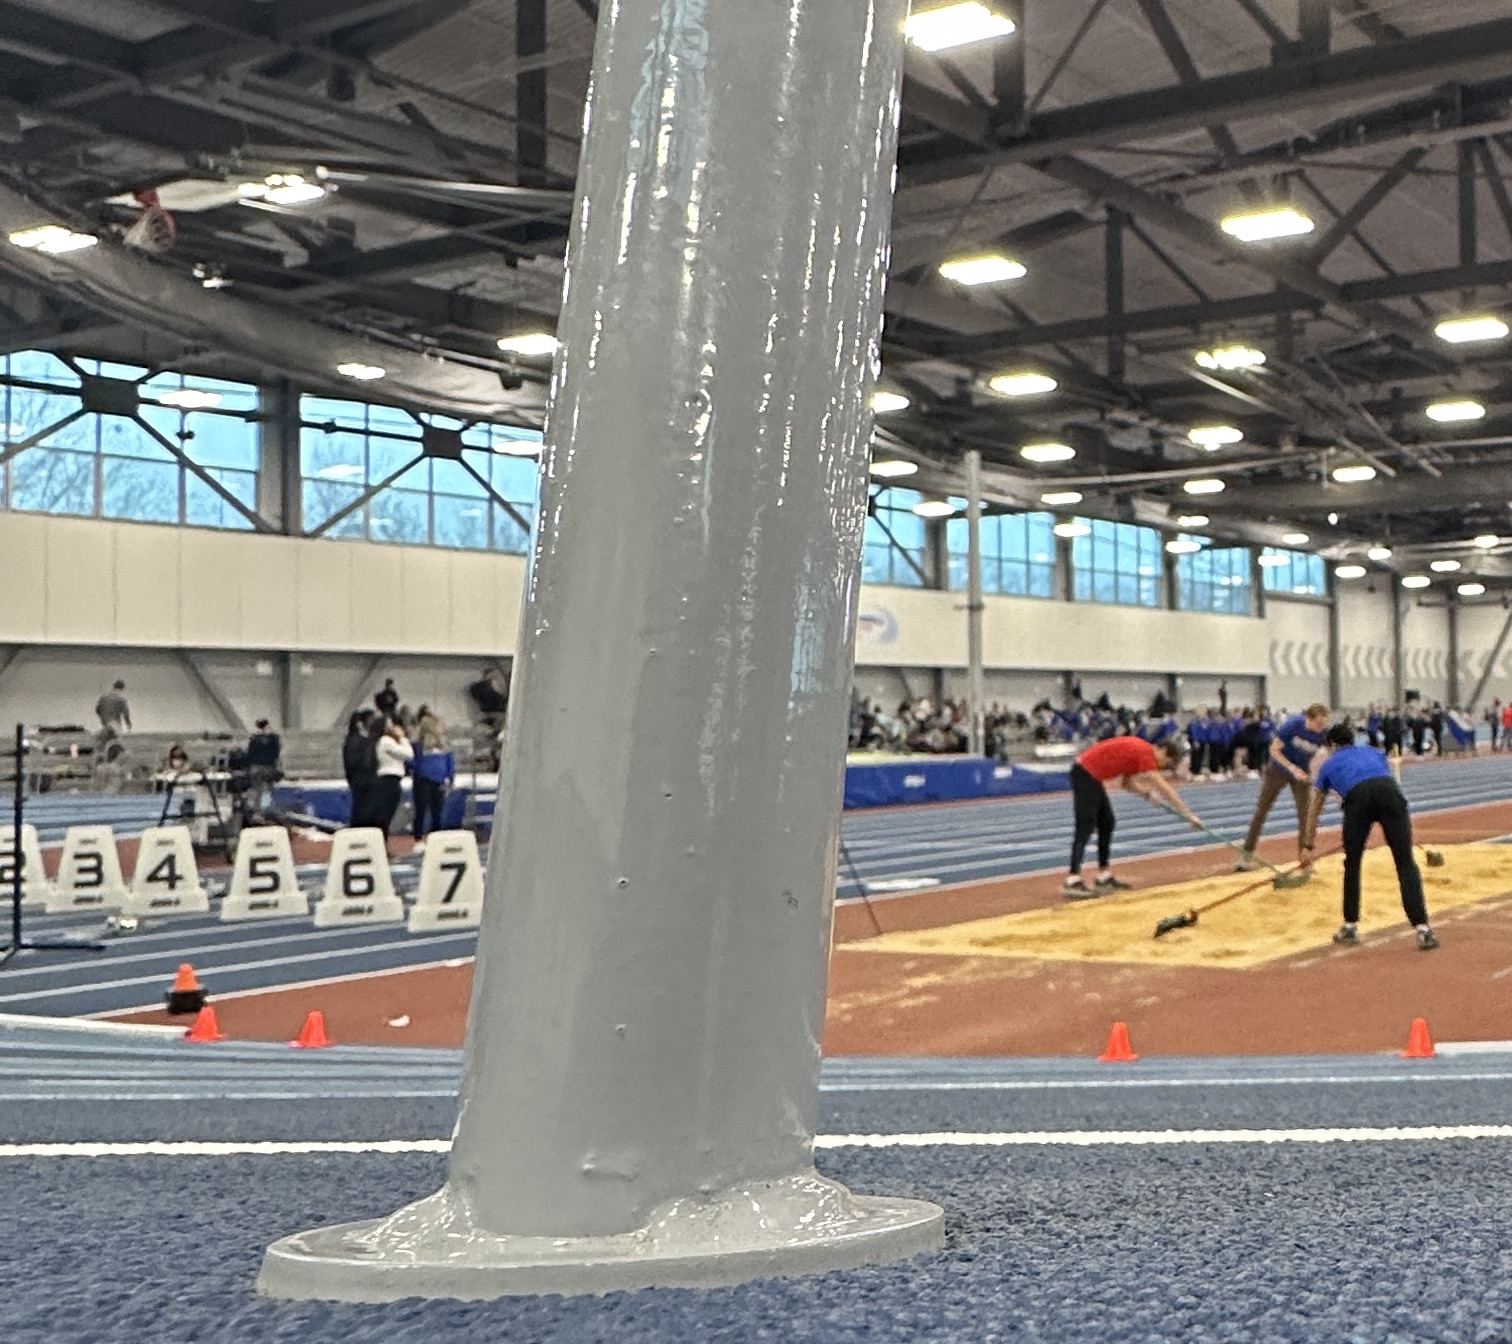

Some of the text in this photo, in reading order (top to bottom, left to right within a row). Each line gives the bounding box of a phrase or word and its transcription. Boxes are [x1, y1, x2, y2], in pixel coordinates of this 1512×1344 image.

[73, 851, 103, 888] 3
[146, 853, 183, 890] 4
[249, 856, 280, 895] 5
[343, 858, 374, 898] 6
[440, 862, 467, 904] 7
